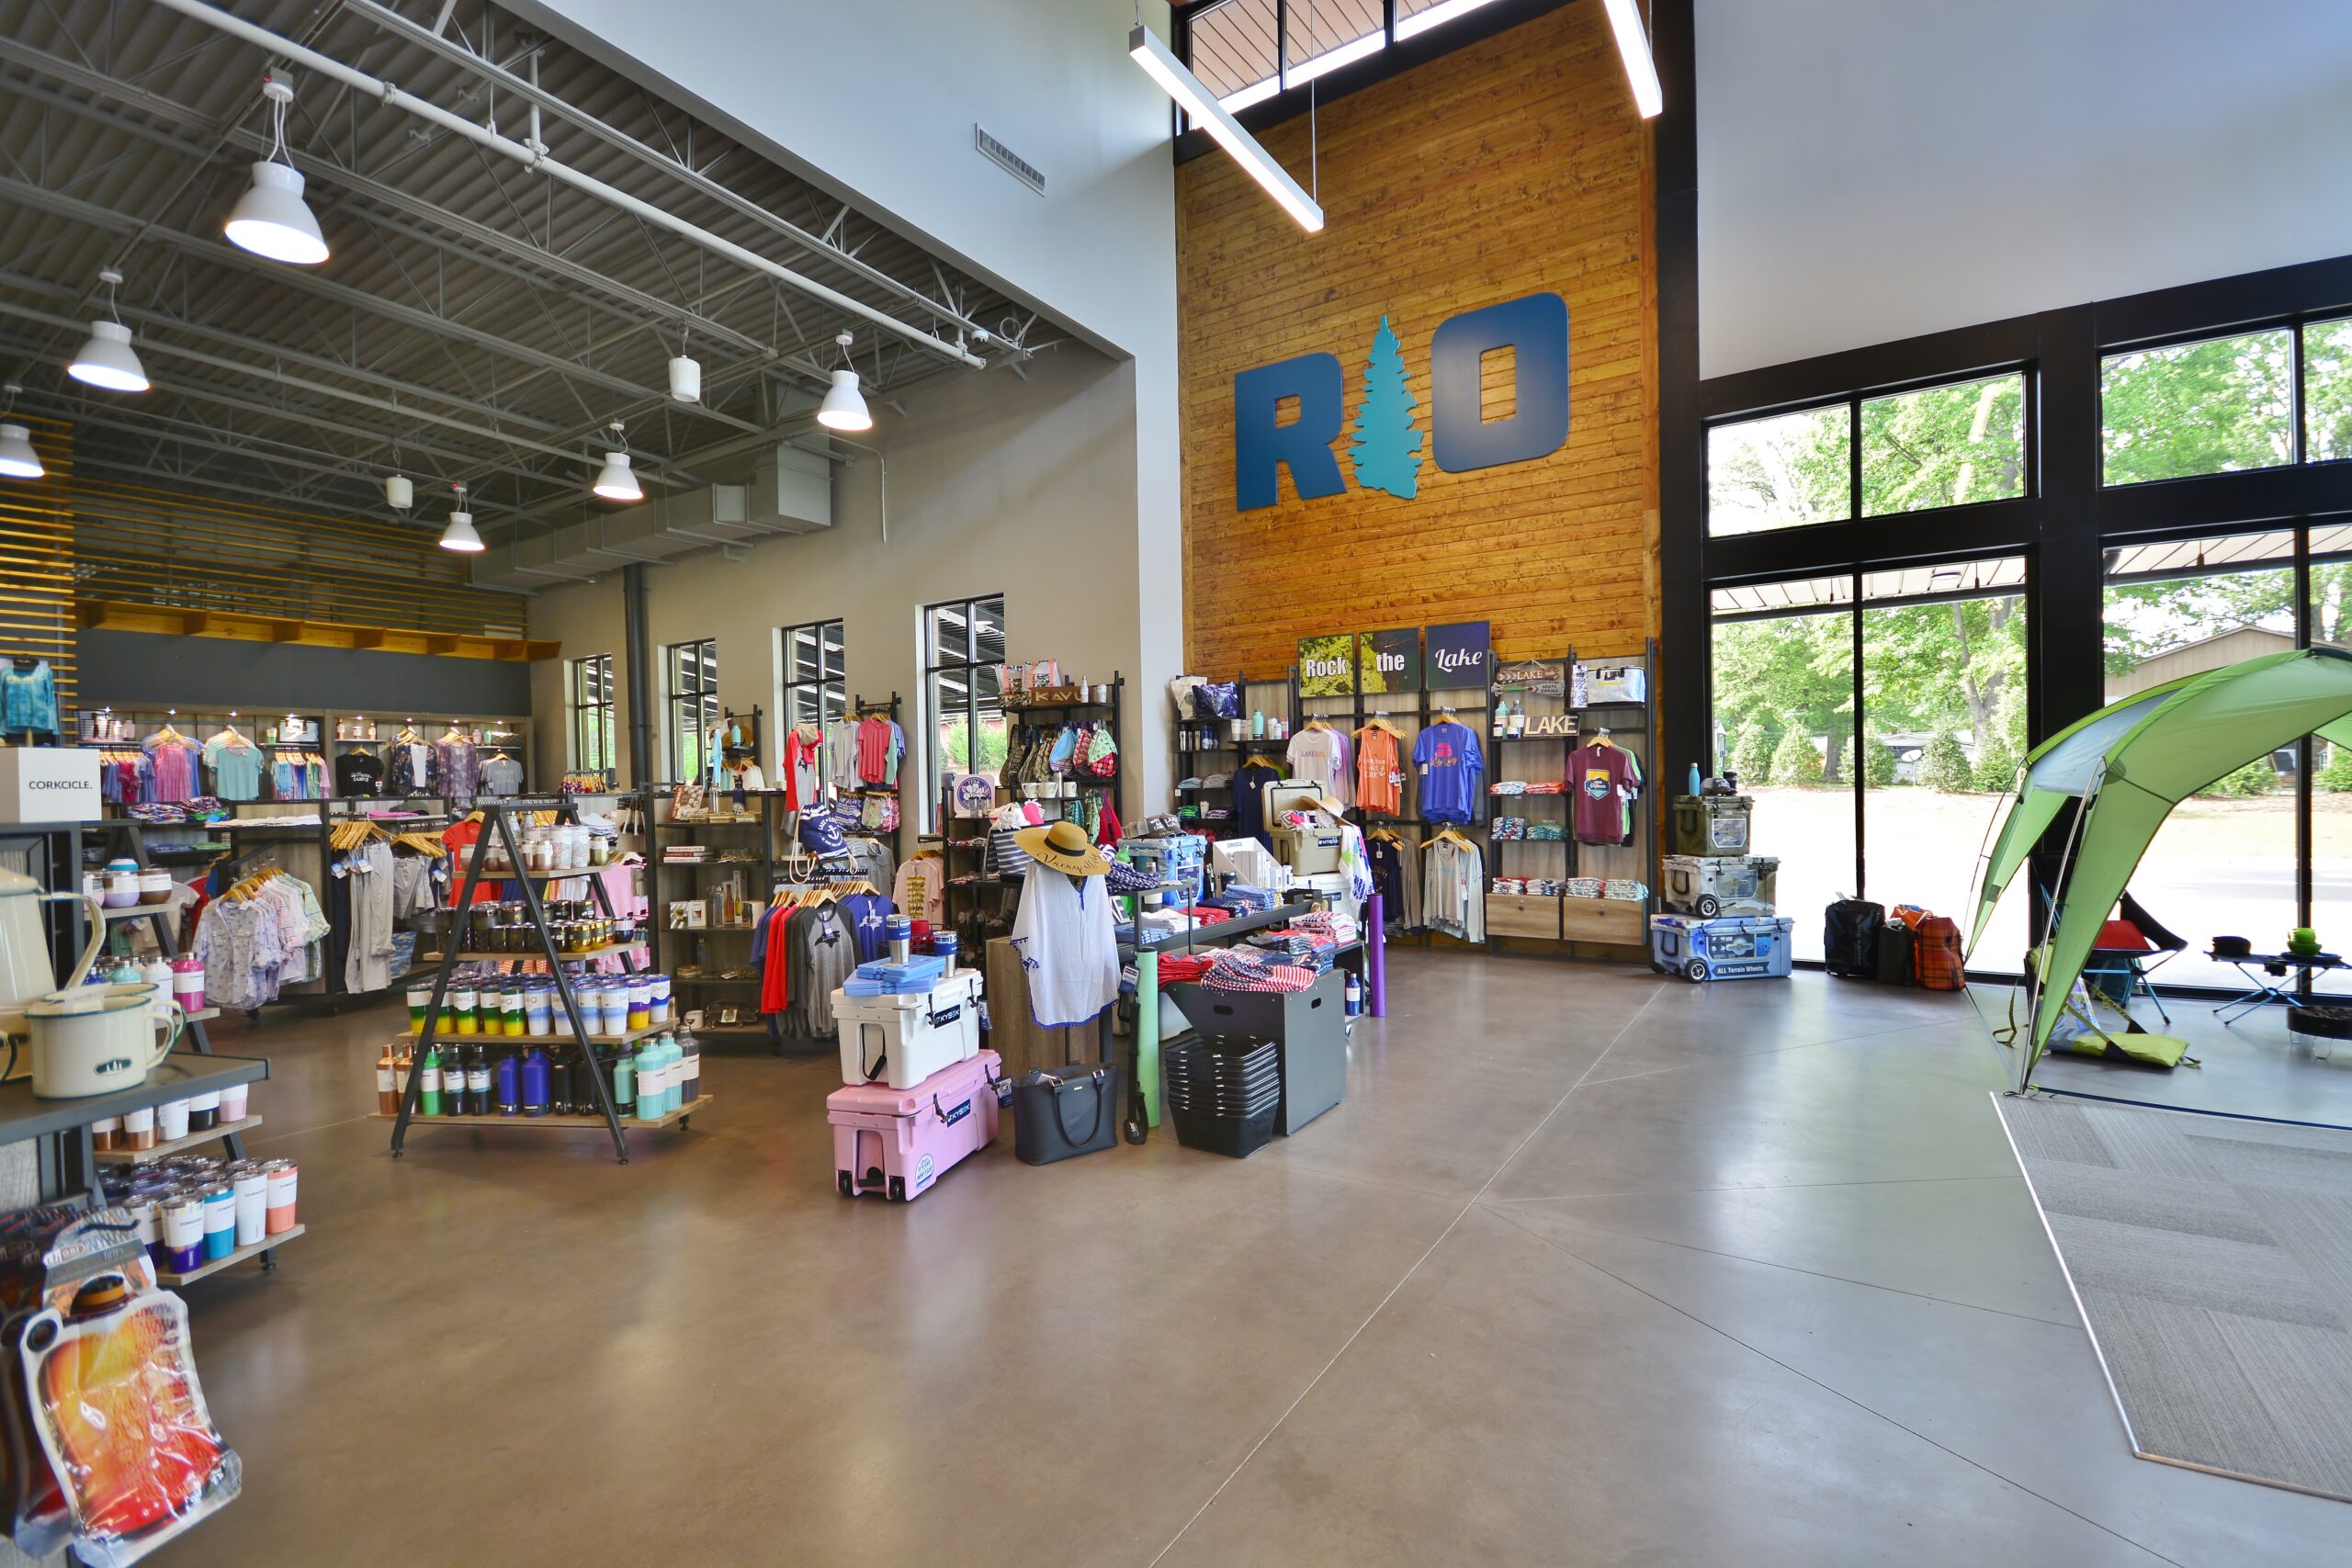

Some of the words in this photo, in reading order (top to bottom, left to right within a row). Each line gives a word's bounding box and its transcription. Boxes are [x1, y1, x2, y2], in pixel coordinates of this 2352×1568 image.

[1306, 657, 1347, 677] Rock
[1376, 653, 1405, 671] the
[1435, 649, 1483, 673] Lake
[1517, 670, 1544, 680] LAKE
[1525, 716, 1578, 735] LAKE
